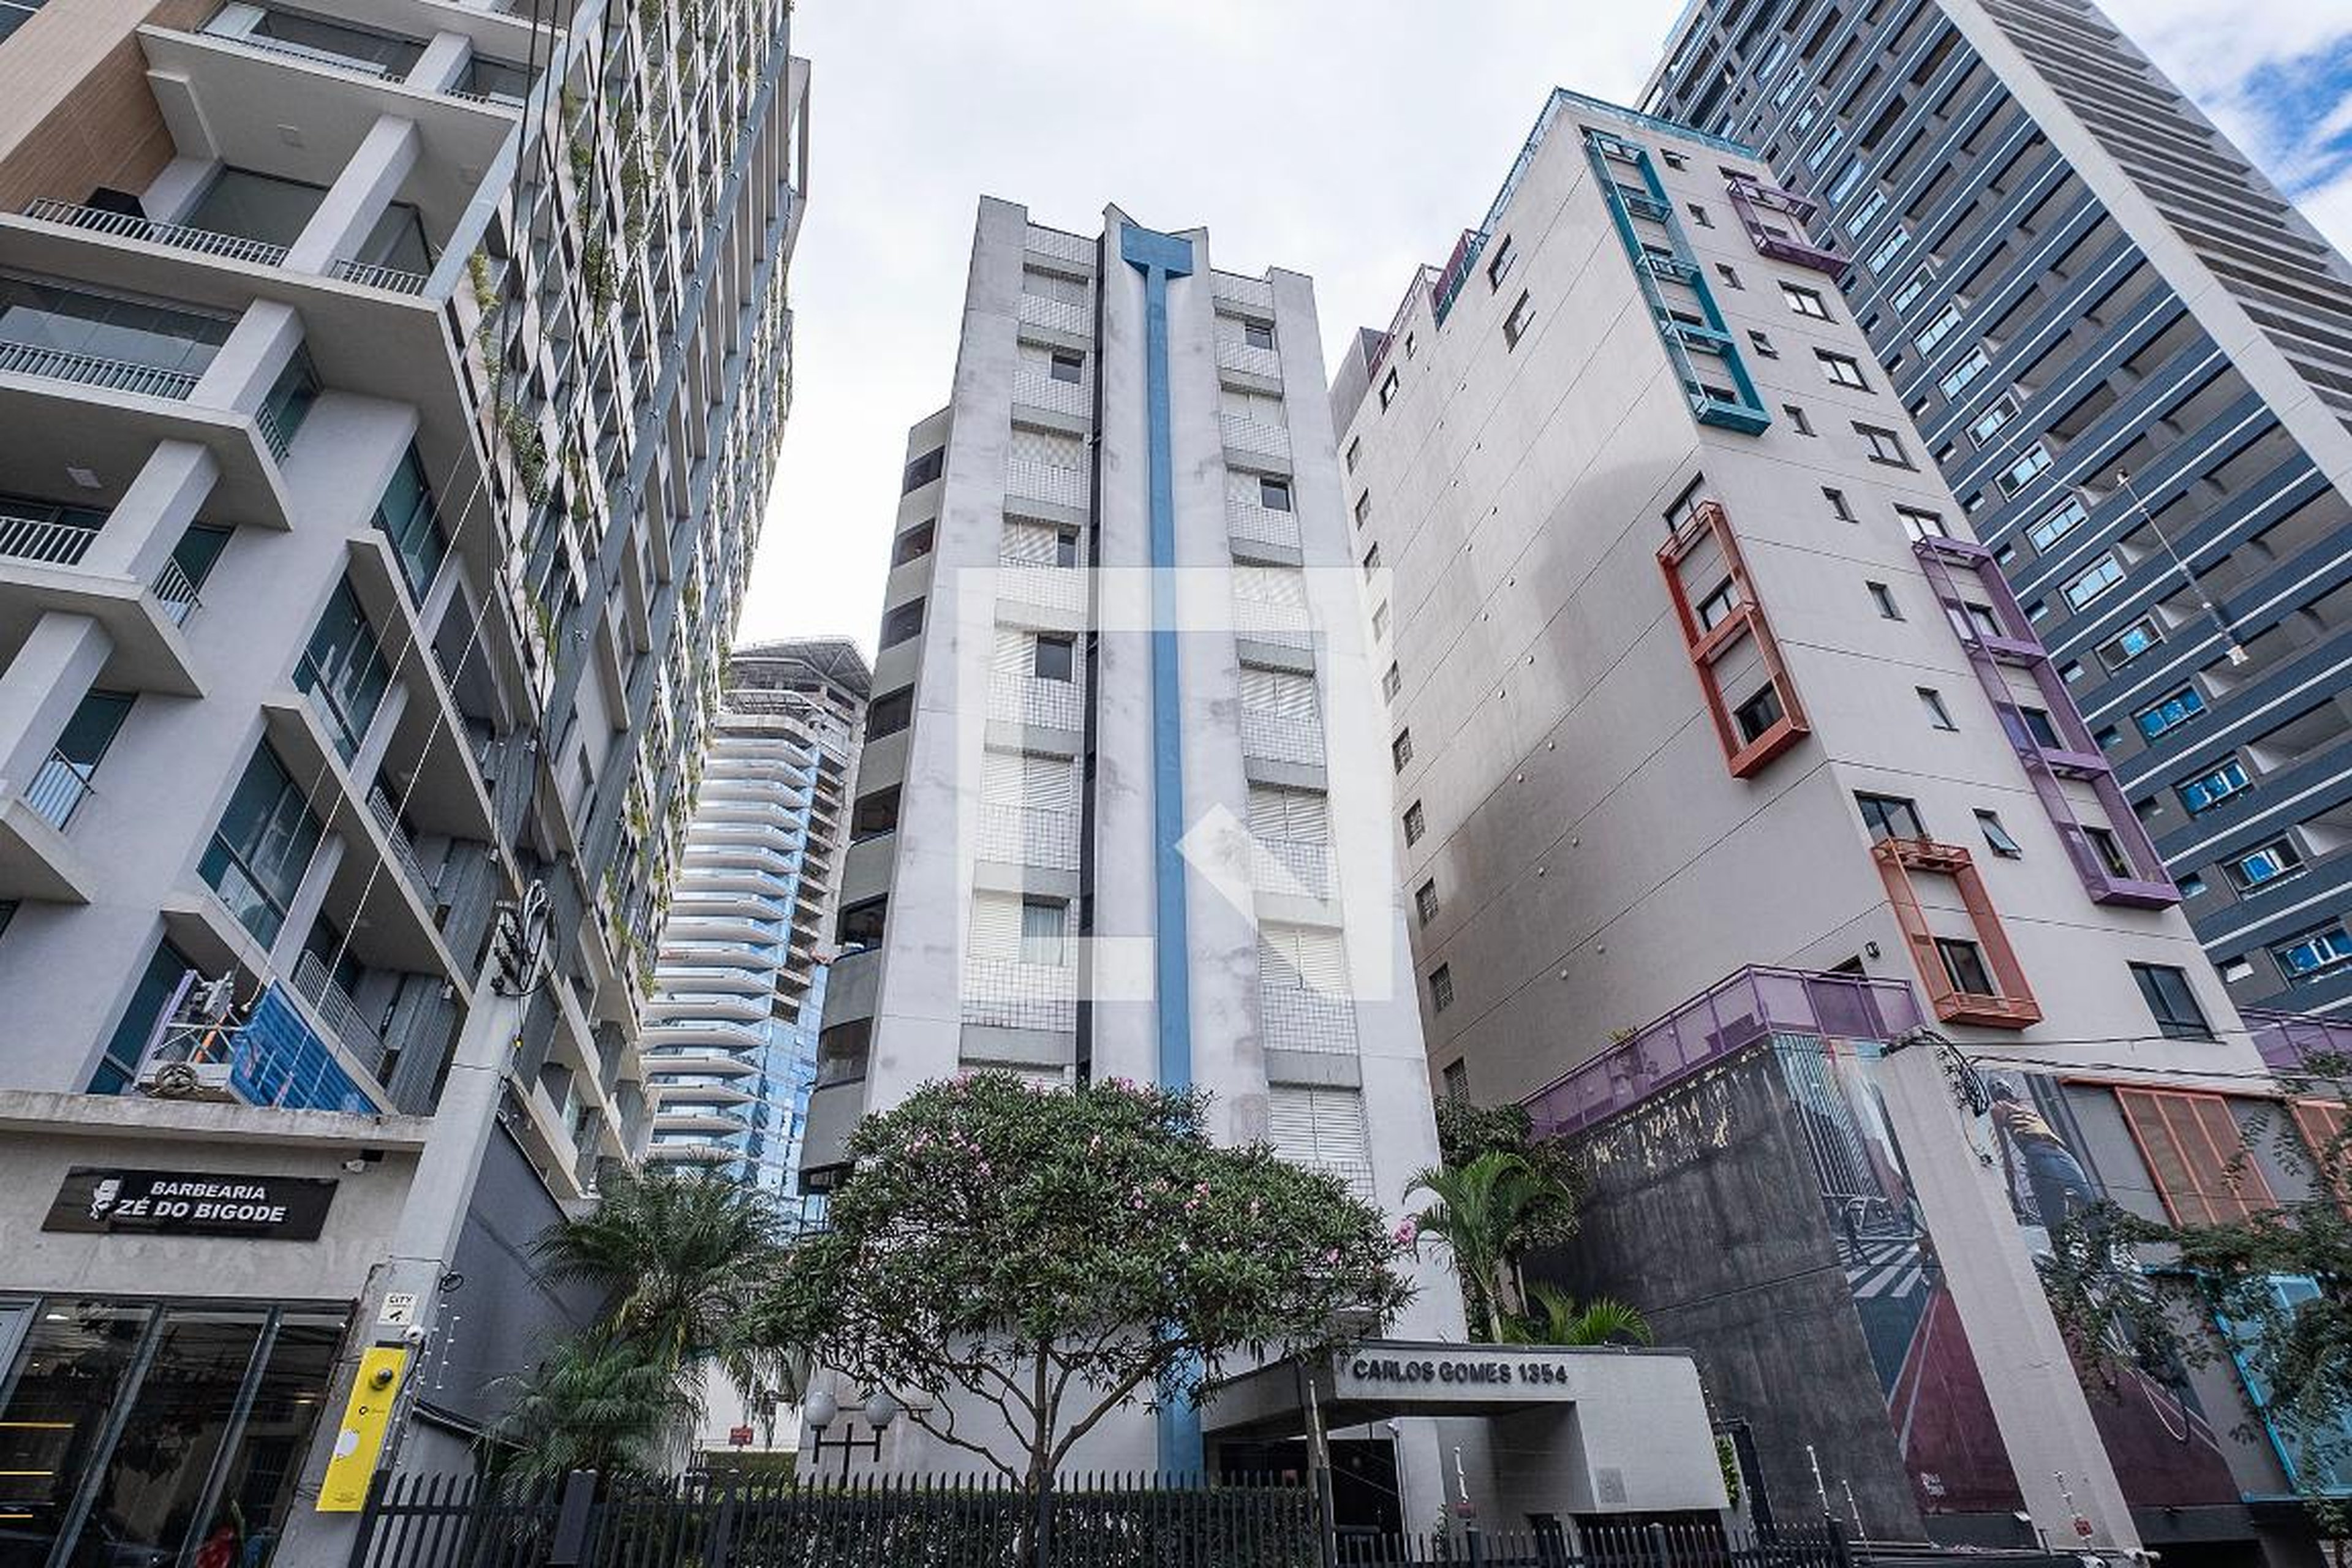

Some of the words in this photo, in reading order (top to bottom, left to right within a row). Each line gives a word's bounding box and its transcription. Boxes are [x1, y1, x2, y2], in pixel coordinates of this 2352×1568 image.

[151, 1181, 266, 1199] BARBEARIA
[114, 1196, 151, 1216] ZÉ
[154, 1201, 189, 1217] DO
[194, 1203, 287, 1222] BIGODE
[1352, 1359, 1436, 1383] CARLOS
[1439, 1361, 1512, 1384] GOMES
[1518, 1362, 1568, 1384] 1354
